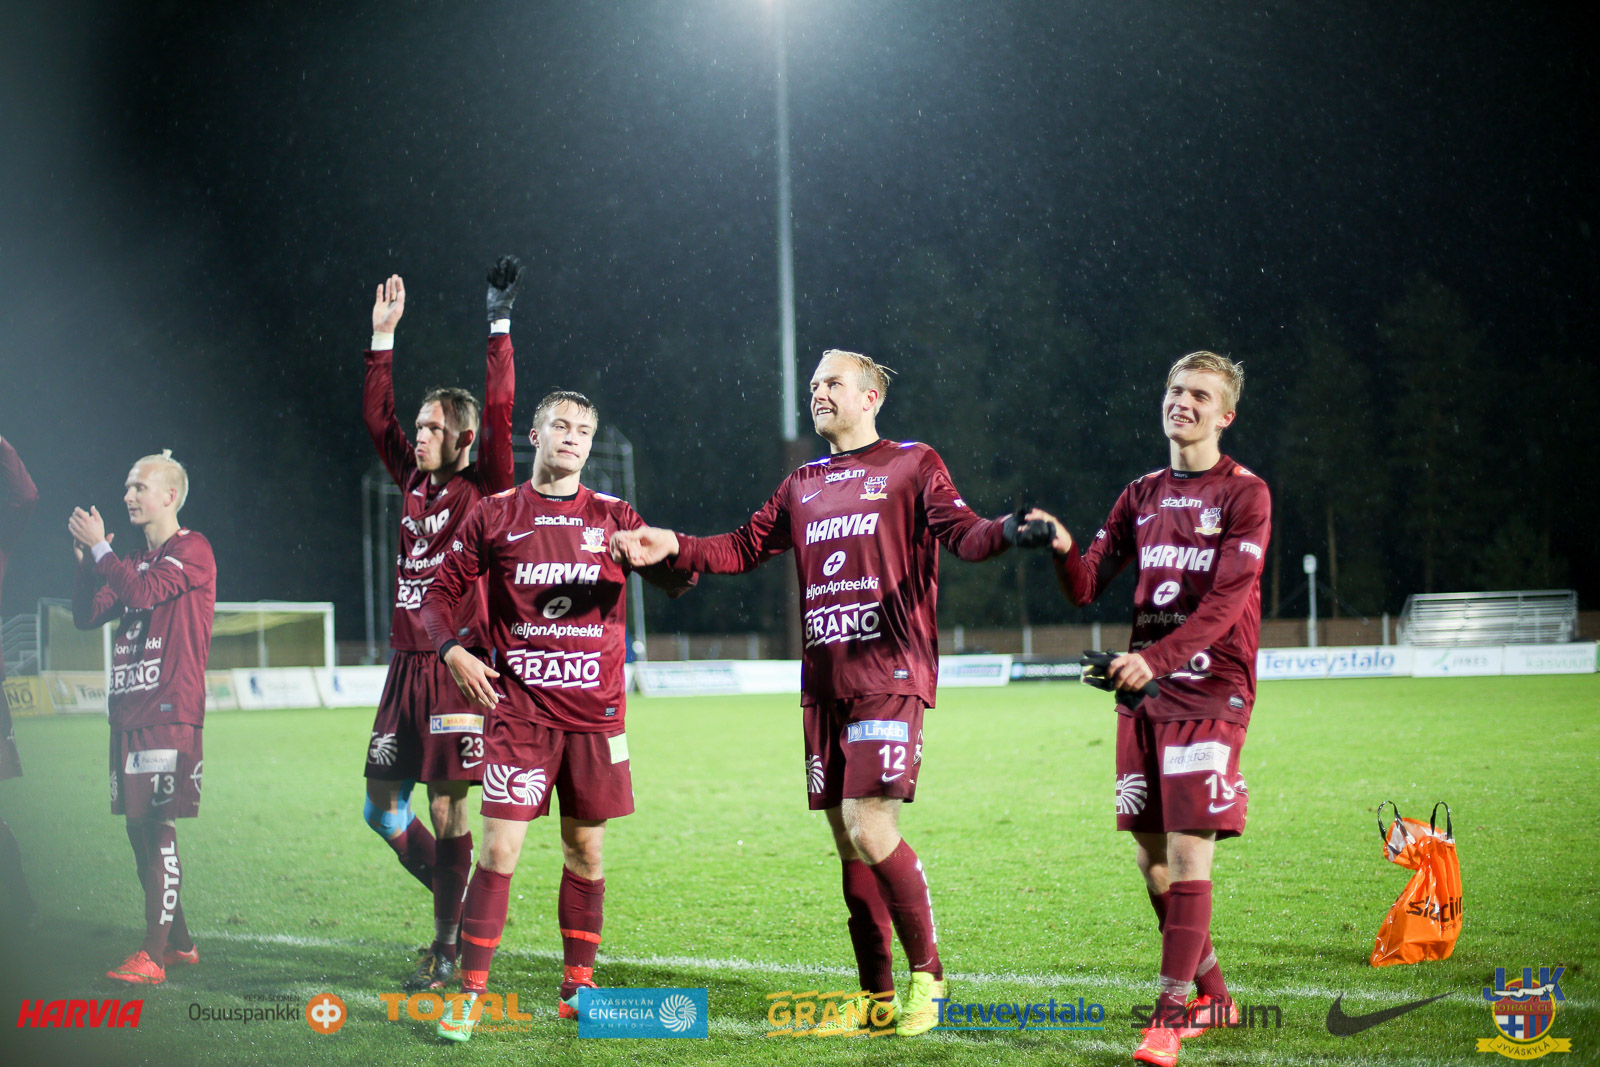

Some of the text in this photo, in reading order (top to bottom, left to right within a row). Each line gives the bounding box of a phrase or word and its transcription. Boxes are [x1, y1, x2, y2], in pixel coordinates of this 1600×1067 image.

[825, 469, 866, 484] stadium
[1160, 496, 1202, 509] stadium
[534, 515, 583, 527] stadium
[805, 513, 879, 545] HARVIA
[1140, 545, 1215, 572] HARVIA
[514, 562, 601, 585] HARVIA
[510, 622, 604, 639] KeljonApteekki
[805, 610, 880, 640] GRANO
[507, 657, 600, 681] GRANO
[1264, 648, 1395, 672] Terveystalo
[865, 724, 904, 738] Lindab
[460, 736, 485, 758] 23
[879, 744, 906, 770] 12
[150, 773, 175, 794] 13
[159, 841, 180, 925] TOTAL
